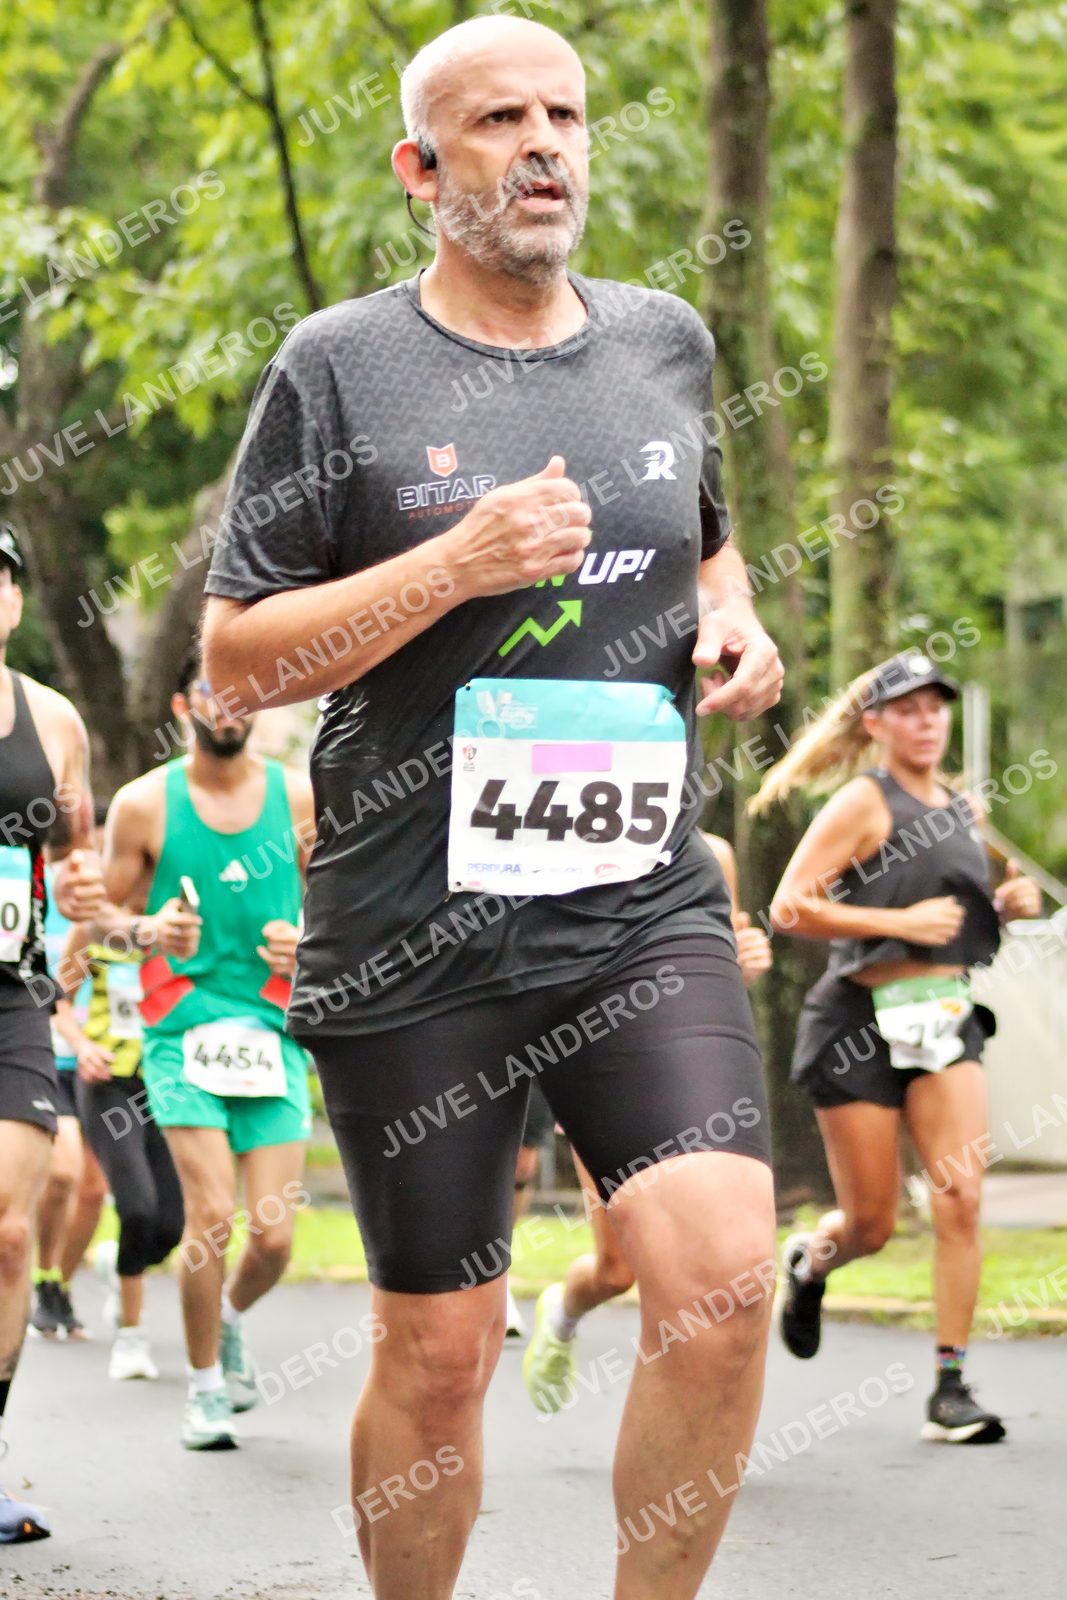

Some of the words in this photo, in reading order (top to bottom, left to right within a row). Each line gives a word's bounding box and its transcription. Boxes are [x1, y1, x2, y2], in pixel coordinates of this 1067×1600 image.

[397, 475, 496, 511] BITAR
[578, 549, 656, 585] UP!
[470, 779, 669, 845] 4485
[467, 863, 521, 874] PERDURA
[193, 1043, 273, 1072] 4454
